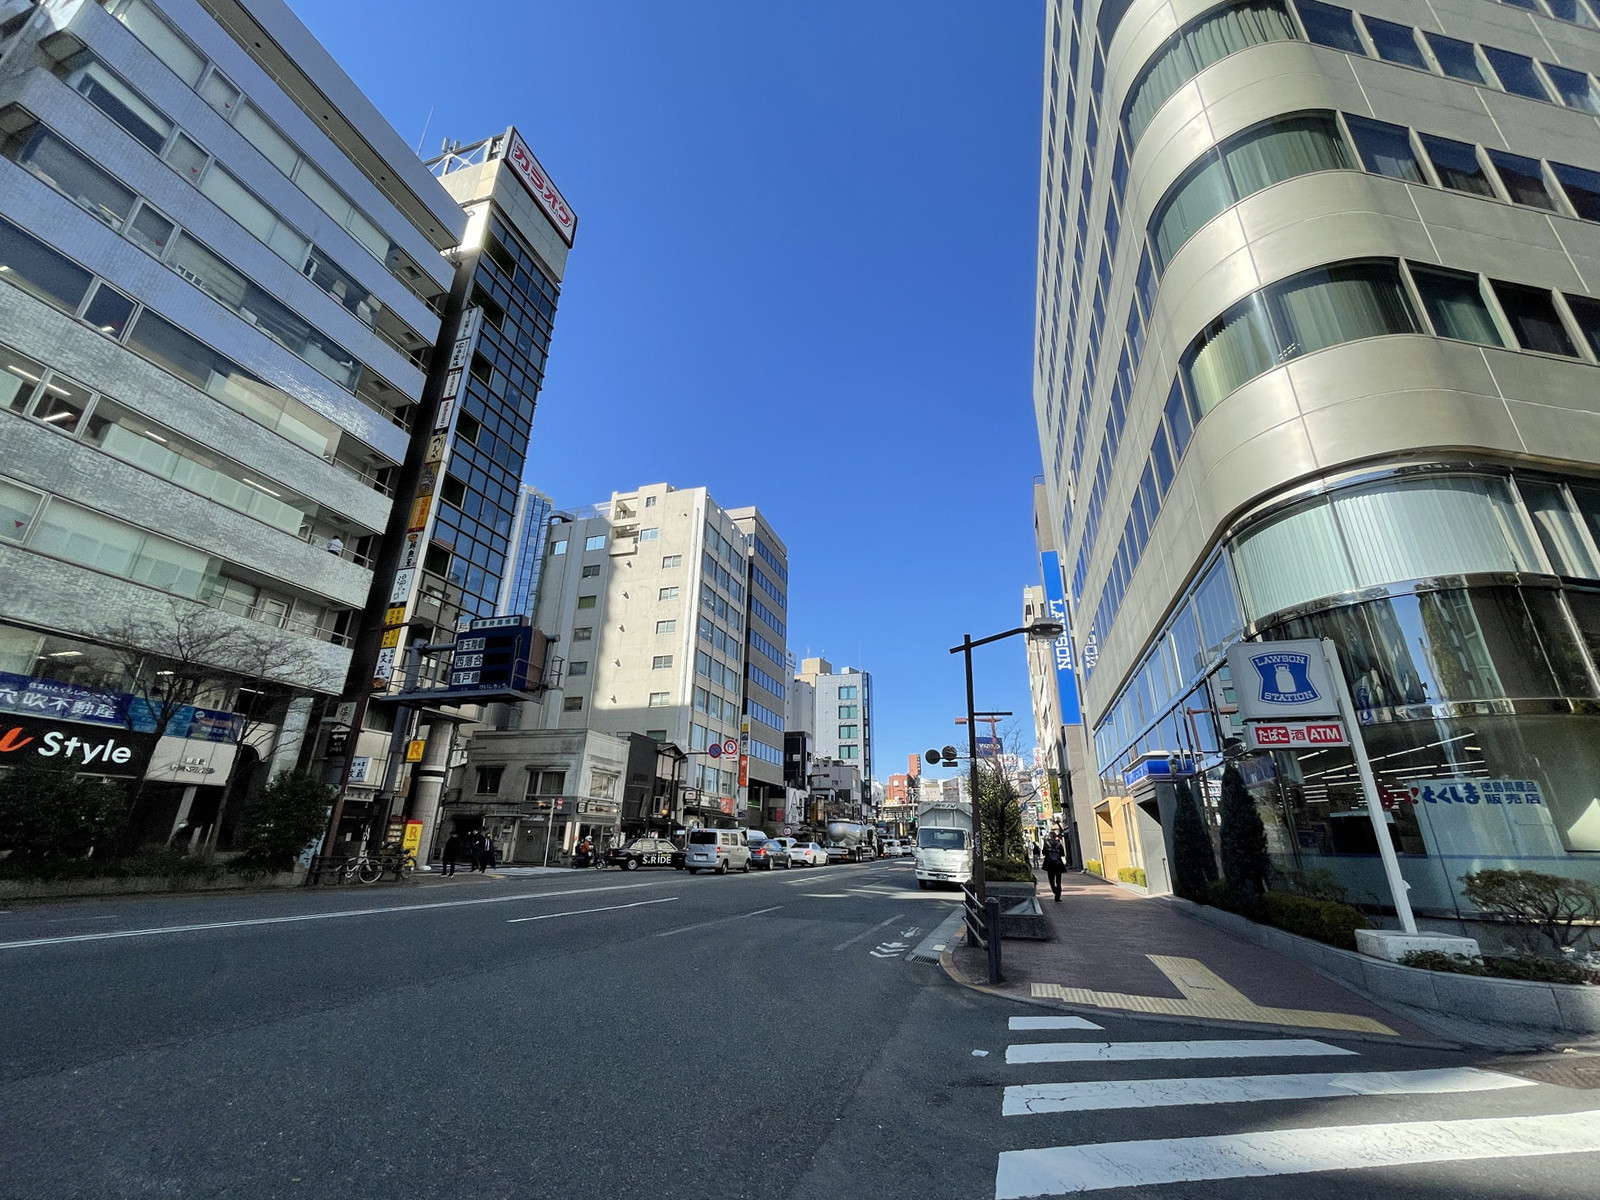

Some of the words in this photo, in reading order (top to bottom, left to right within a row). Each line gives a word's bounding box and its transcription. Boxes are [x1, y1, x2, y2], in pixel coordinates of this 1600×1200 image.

[1049, 599, 1071, 670] LASON
[455, 655, 482, 667] 西落合
[1255, 655, 1305, 666] LAWSON
[1264, 690, 1314, 702] STATION
[1258, 728, 1289, 741] たばこ
[1310, 728, 1340, 740] ATM
[38, 731, 132, 765] Style
[1422, 782, 1481, 804] とくしま
[1485, 794, 1541, 804] 販売店
[642, 856, 672, 864] S.RIDE
